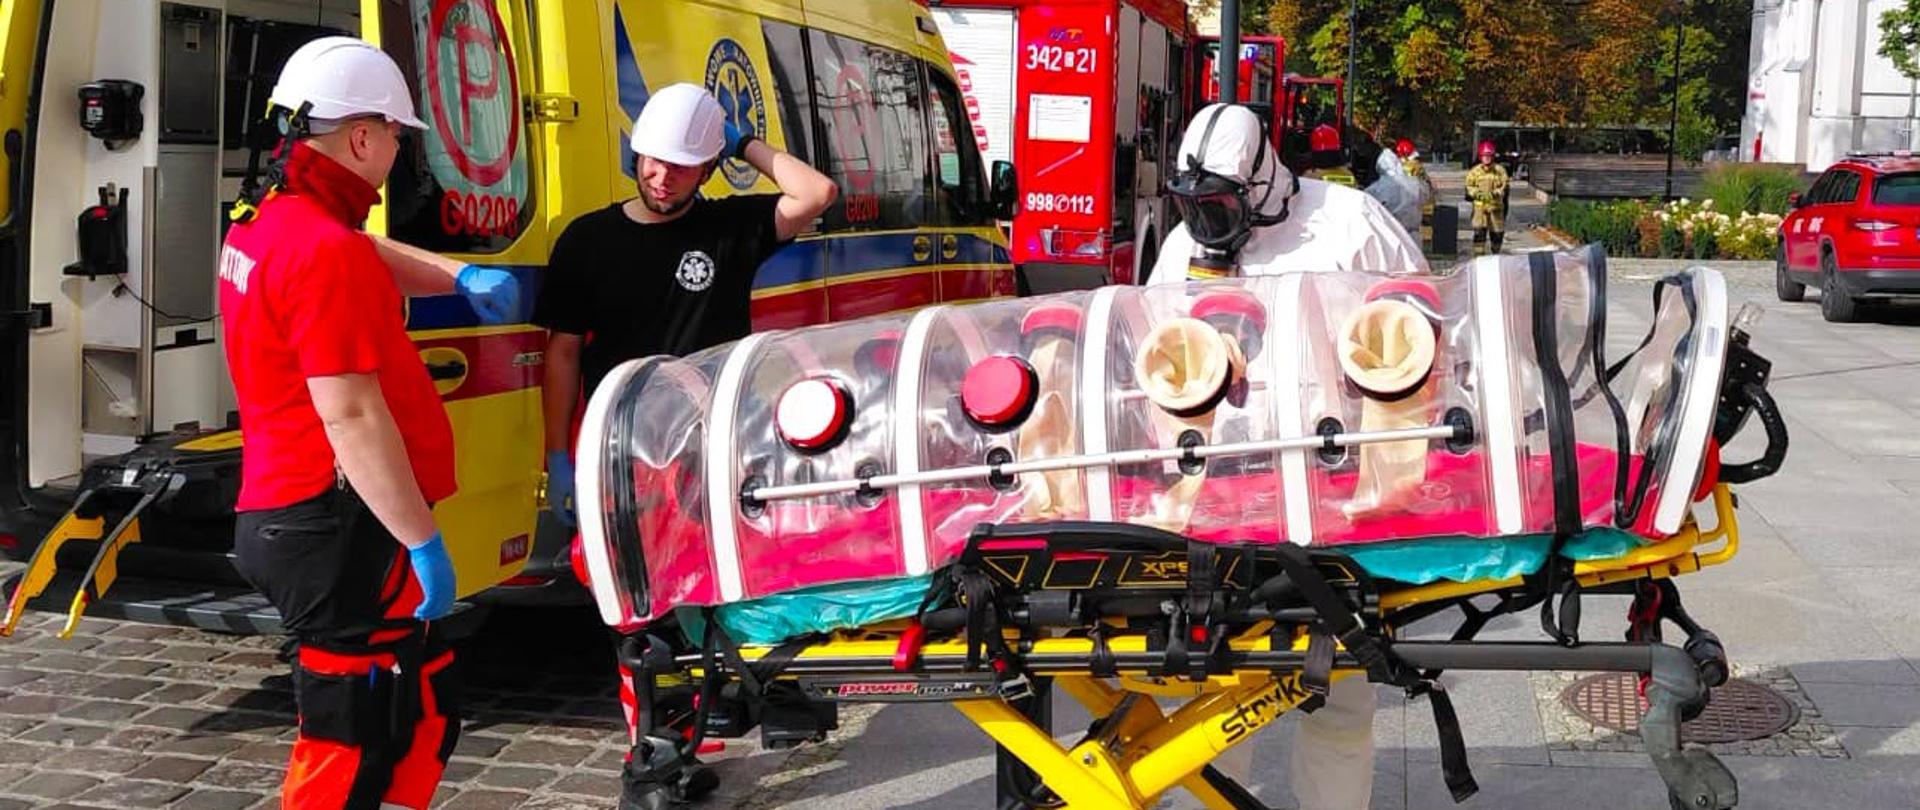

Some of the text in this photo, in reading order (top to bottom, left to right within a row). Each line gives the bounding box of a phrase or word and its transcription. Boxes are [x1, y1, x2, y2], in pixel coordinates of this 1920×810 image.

[1025, 44, 1063, 72] 342
[1076, 48, 1097, 73] 21
[440, 188, 519, 237] G0208
[1027, 192, 1094, 215] 998 112
[1221, 672, 1311, 744] stryk
